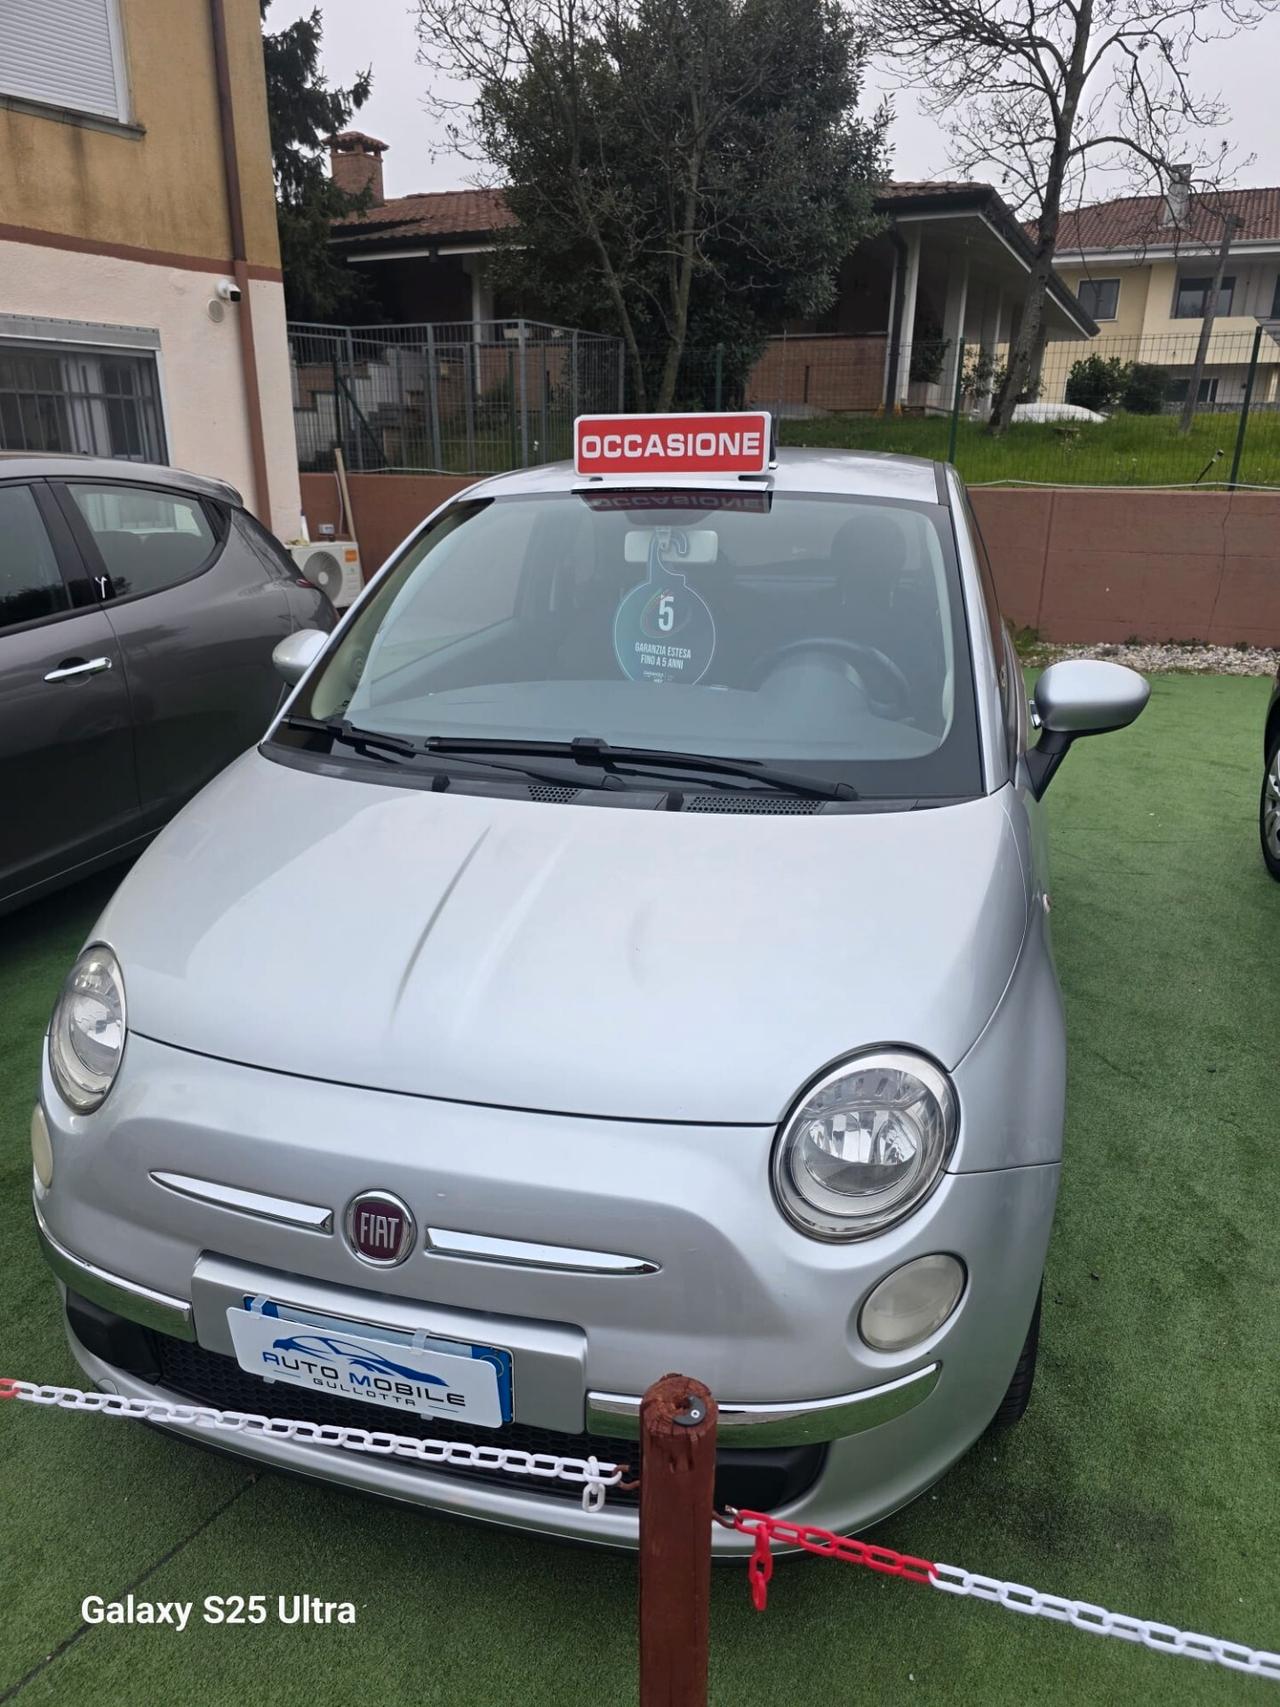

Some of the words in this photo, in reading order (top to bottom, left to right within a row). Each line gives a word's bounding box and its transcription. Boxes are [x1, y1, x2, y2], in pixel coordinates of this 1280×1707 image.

[582, 432, 760, 458] OCCASIONE
[658, 594, 674, 631] 5
[635, 642, 666, 656] GARANZIA
[667, 646, 691, 659] ESTESA
[640, 654, 655, 666] FINO
[655, 656, 661, 667] A
[661, 657, 667, 668] 5
[667, 659, 684, 670] ANNI
[360, 1212, 400, 1249] FIAT
[262, 1351, 339, 1380] AUTO
[349, 1372, 466, 1408] MOBILE
[313, 1377, 416, 1407] GULLOTTA
